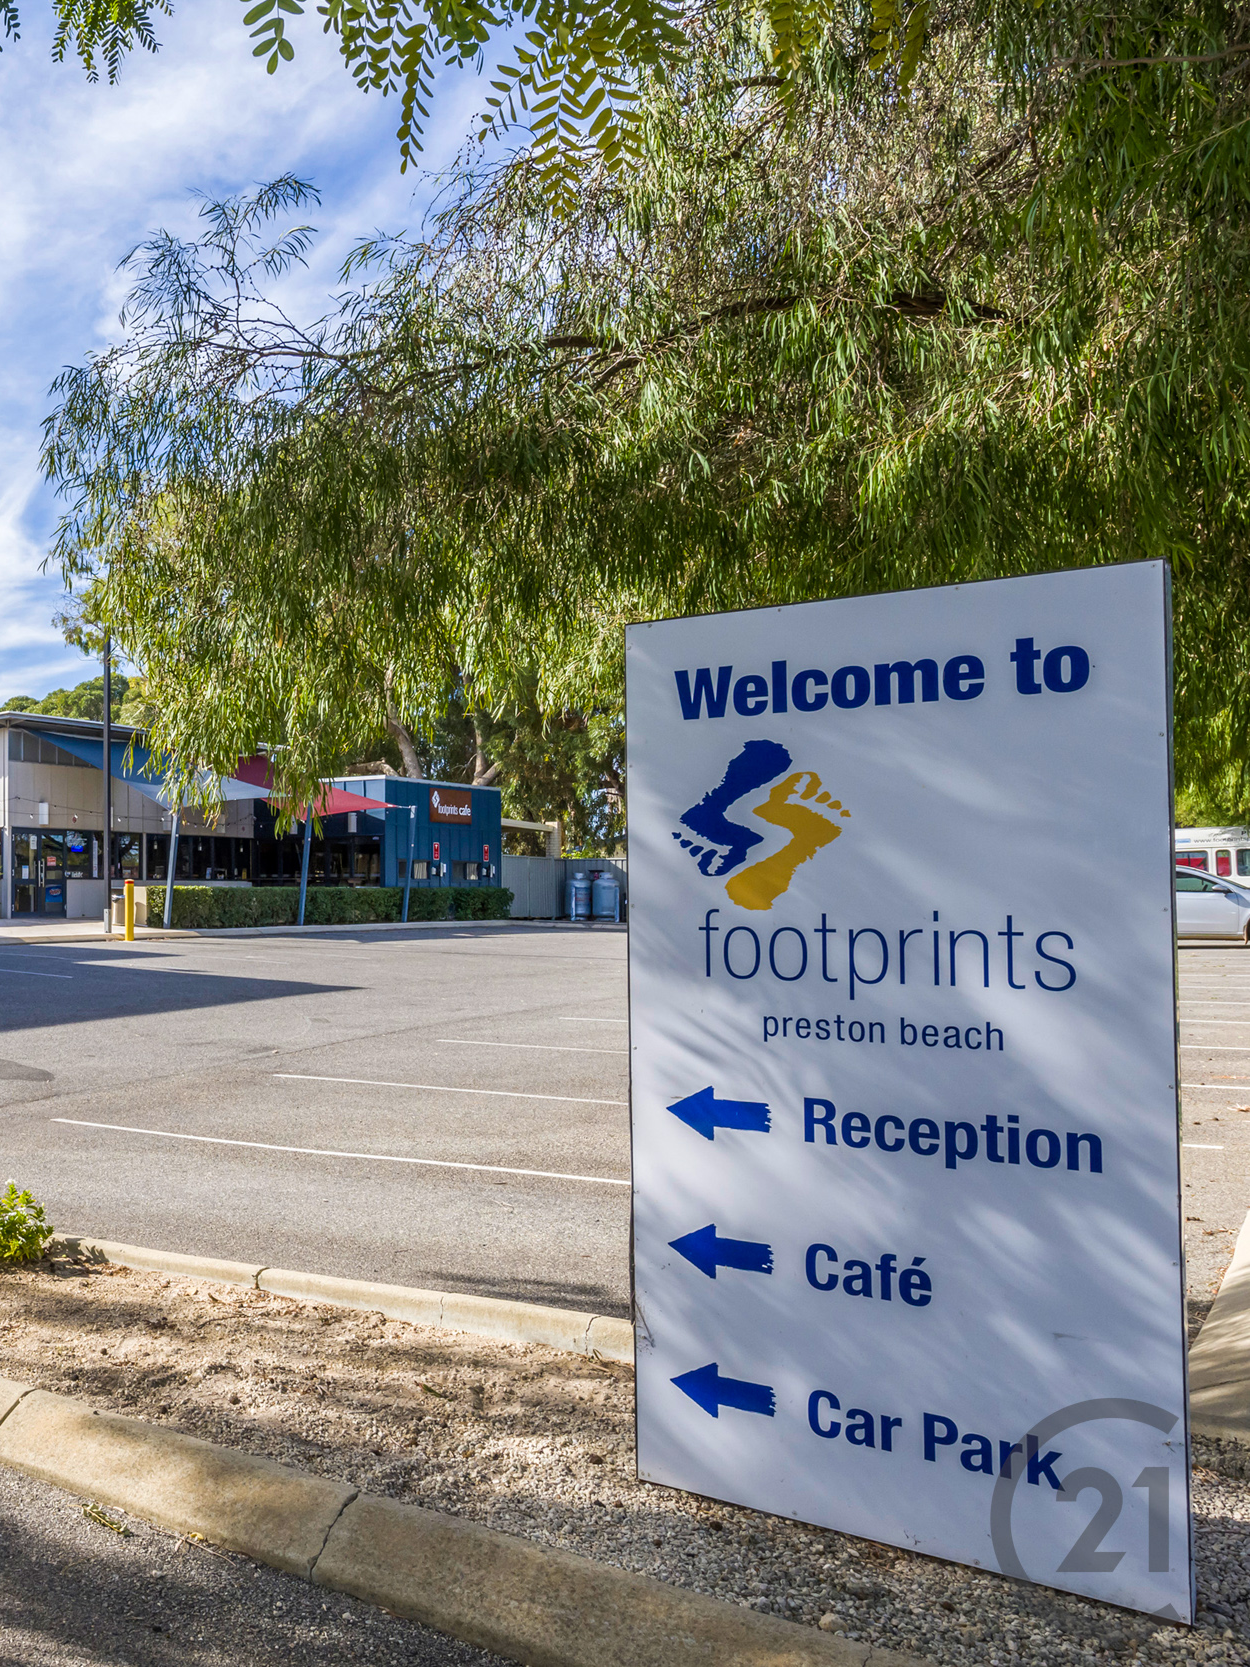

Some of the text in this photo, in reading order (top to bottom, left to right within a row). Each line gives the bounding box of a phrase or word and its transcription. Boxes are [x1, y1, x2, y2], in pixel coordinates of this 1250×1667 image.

[674, 637, 1091, 721] Welcome to
[458, 804, 471, 816] cafe
[698, 909, 1078, 1000] footprints
[762, 1014, 1005, 1051] preston beach
[802, 1096, 1104, 1174] Reception
[804, 1242, 933, 1306] Café
[807, 1389, 1066, 1492] Car Park
